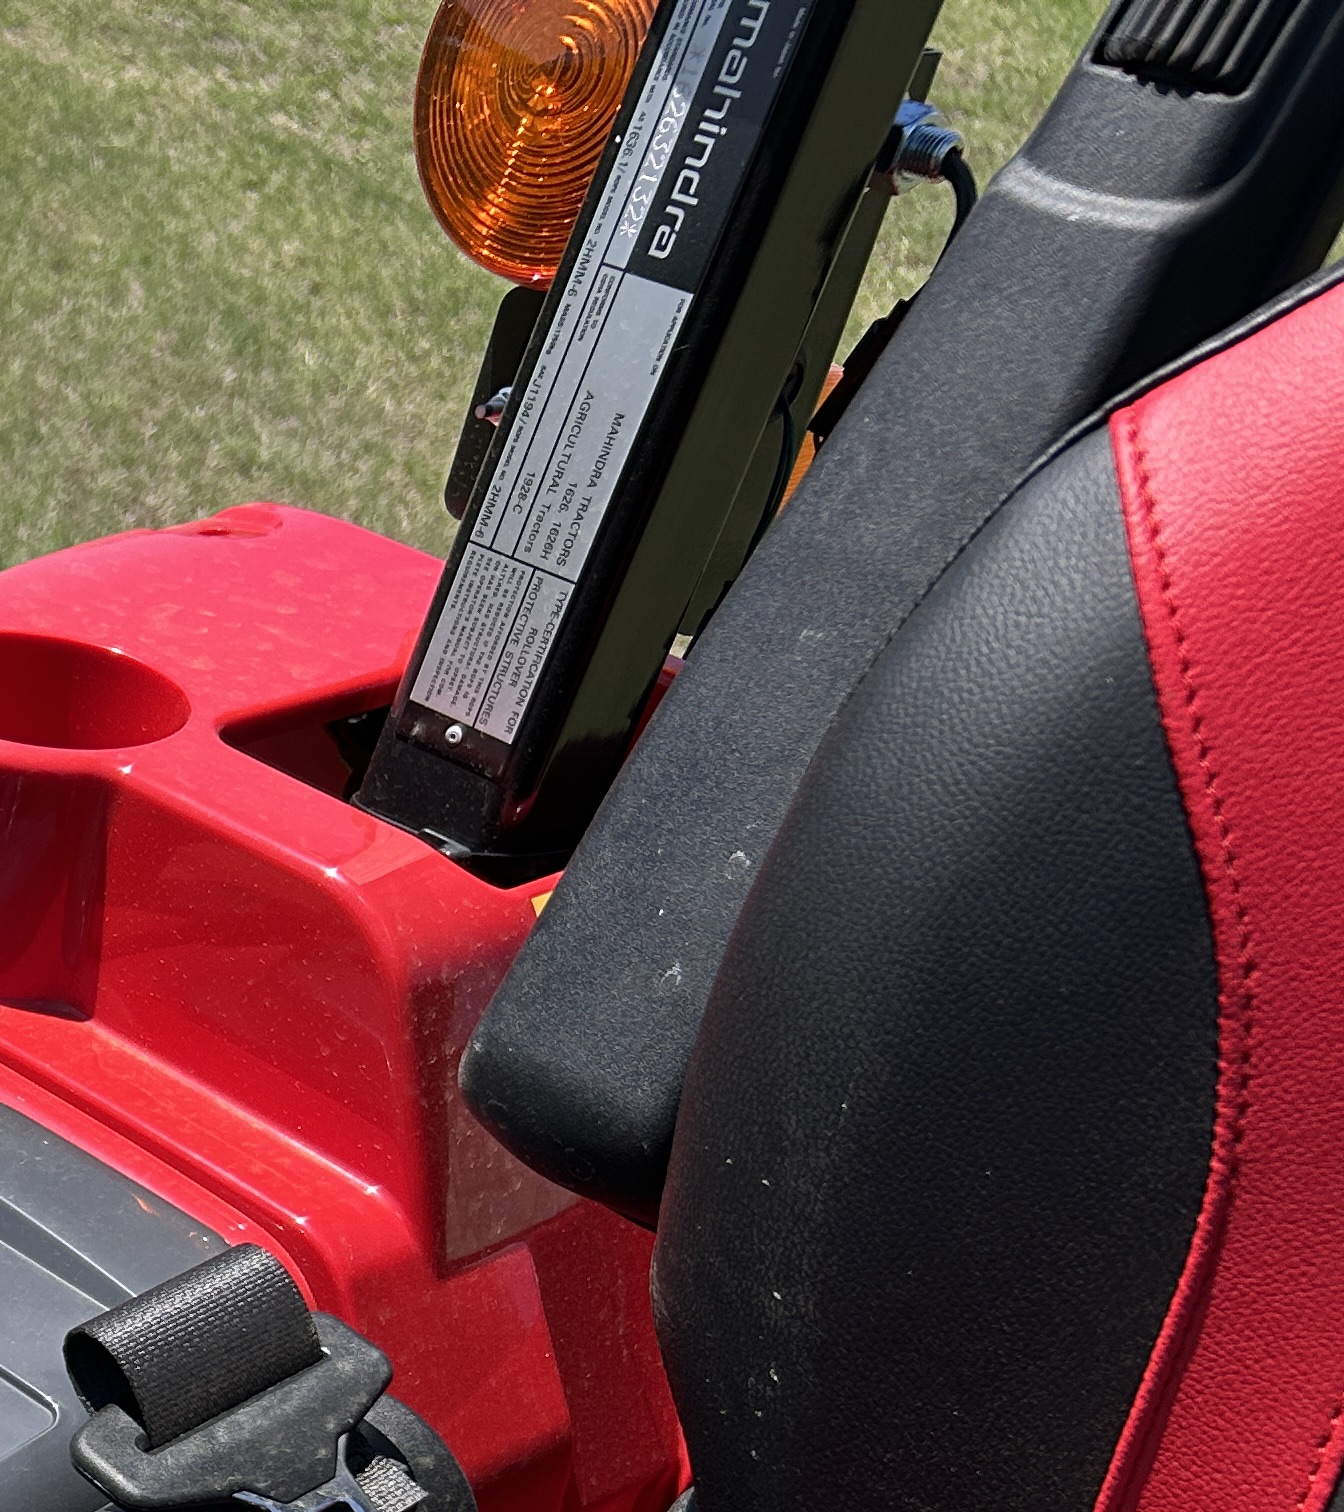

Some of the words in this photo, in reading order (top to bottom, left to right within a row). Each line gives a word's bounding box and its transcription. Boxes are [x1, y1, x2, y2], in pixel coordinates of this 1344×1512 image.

[647, 0, 771, 260] mahindra
[567, 238, 597, 297] 2HMM-6
[545, 390, 594, 494] AGRICULTURAL
[586, 412, 625, 487] MAHINDRA
[474, 484, 501, 538] 2HMM-6
[512, 472, 535, 514] 1928-C
[523, 503, 552, 553] Tractors
[539, 521, 561, 560] 1626H
[555, 495, 592, 566] TRACTORS
[509, 575, 544, 647] PROTECTIVE
[507, 626, 538, 688] ROLLOVER
[514, 591, 568, 706] TYPE-CERTIFICATION
[478, 650, 514, 726] STRUCTURES
[503, 710, 520, 734] FOR
